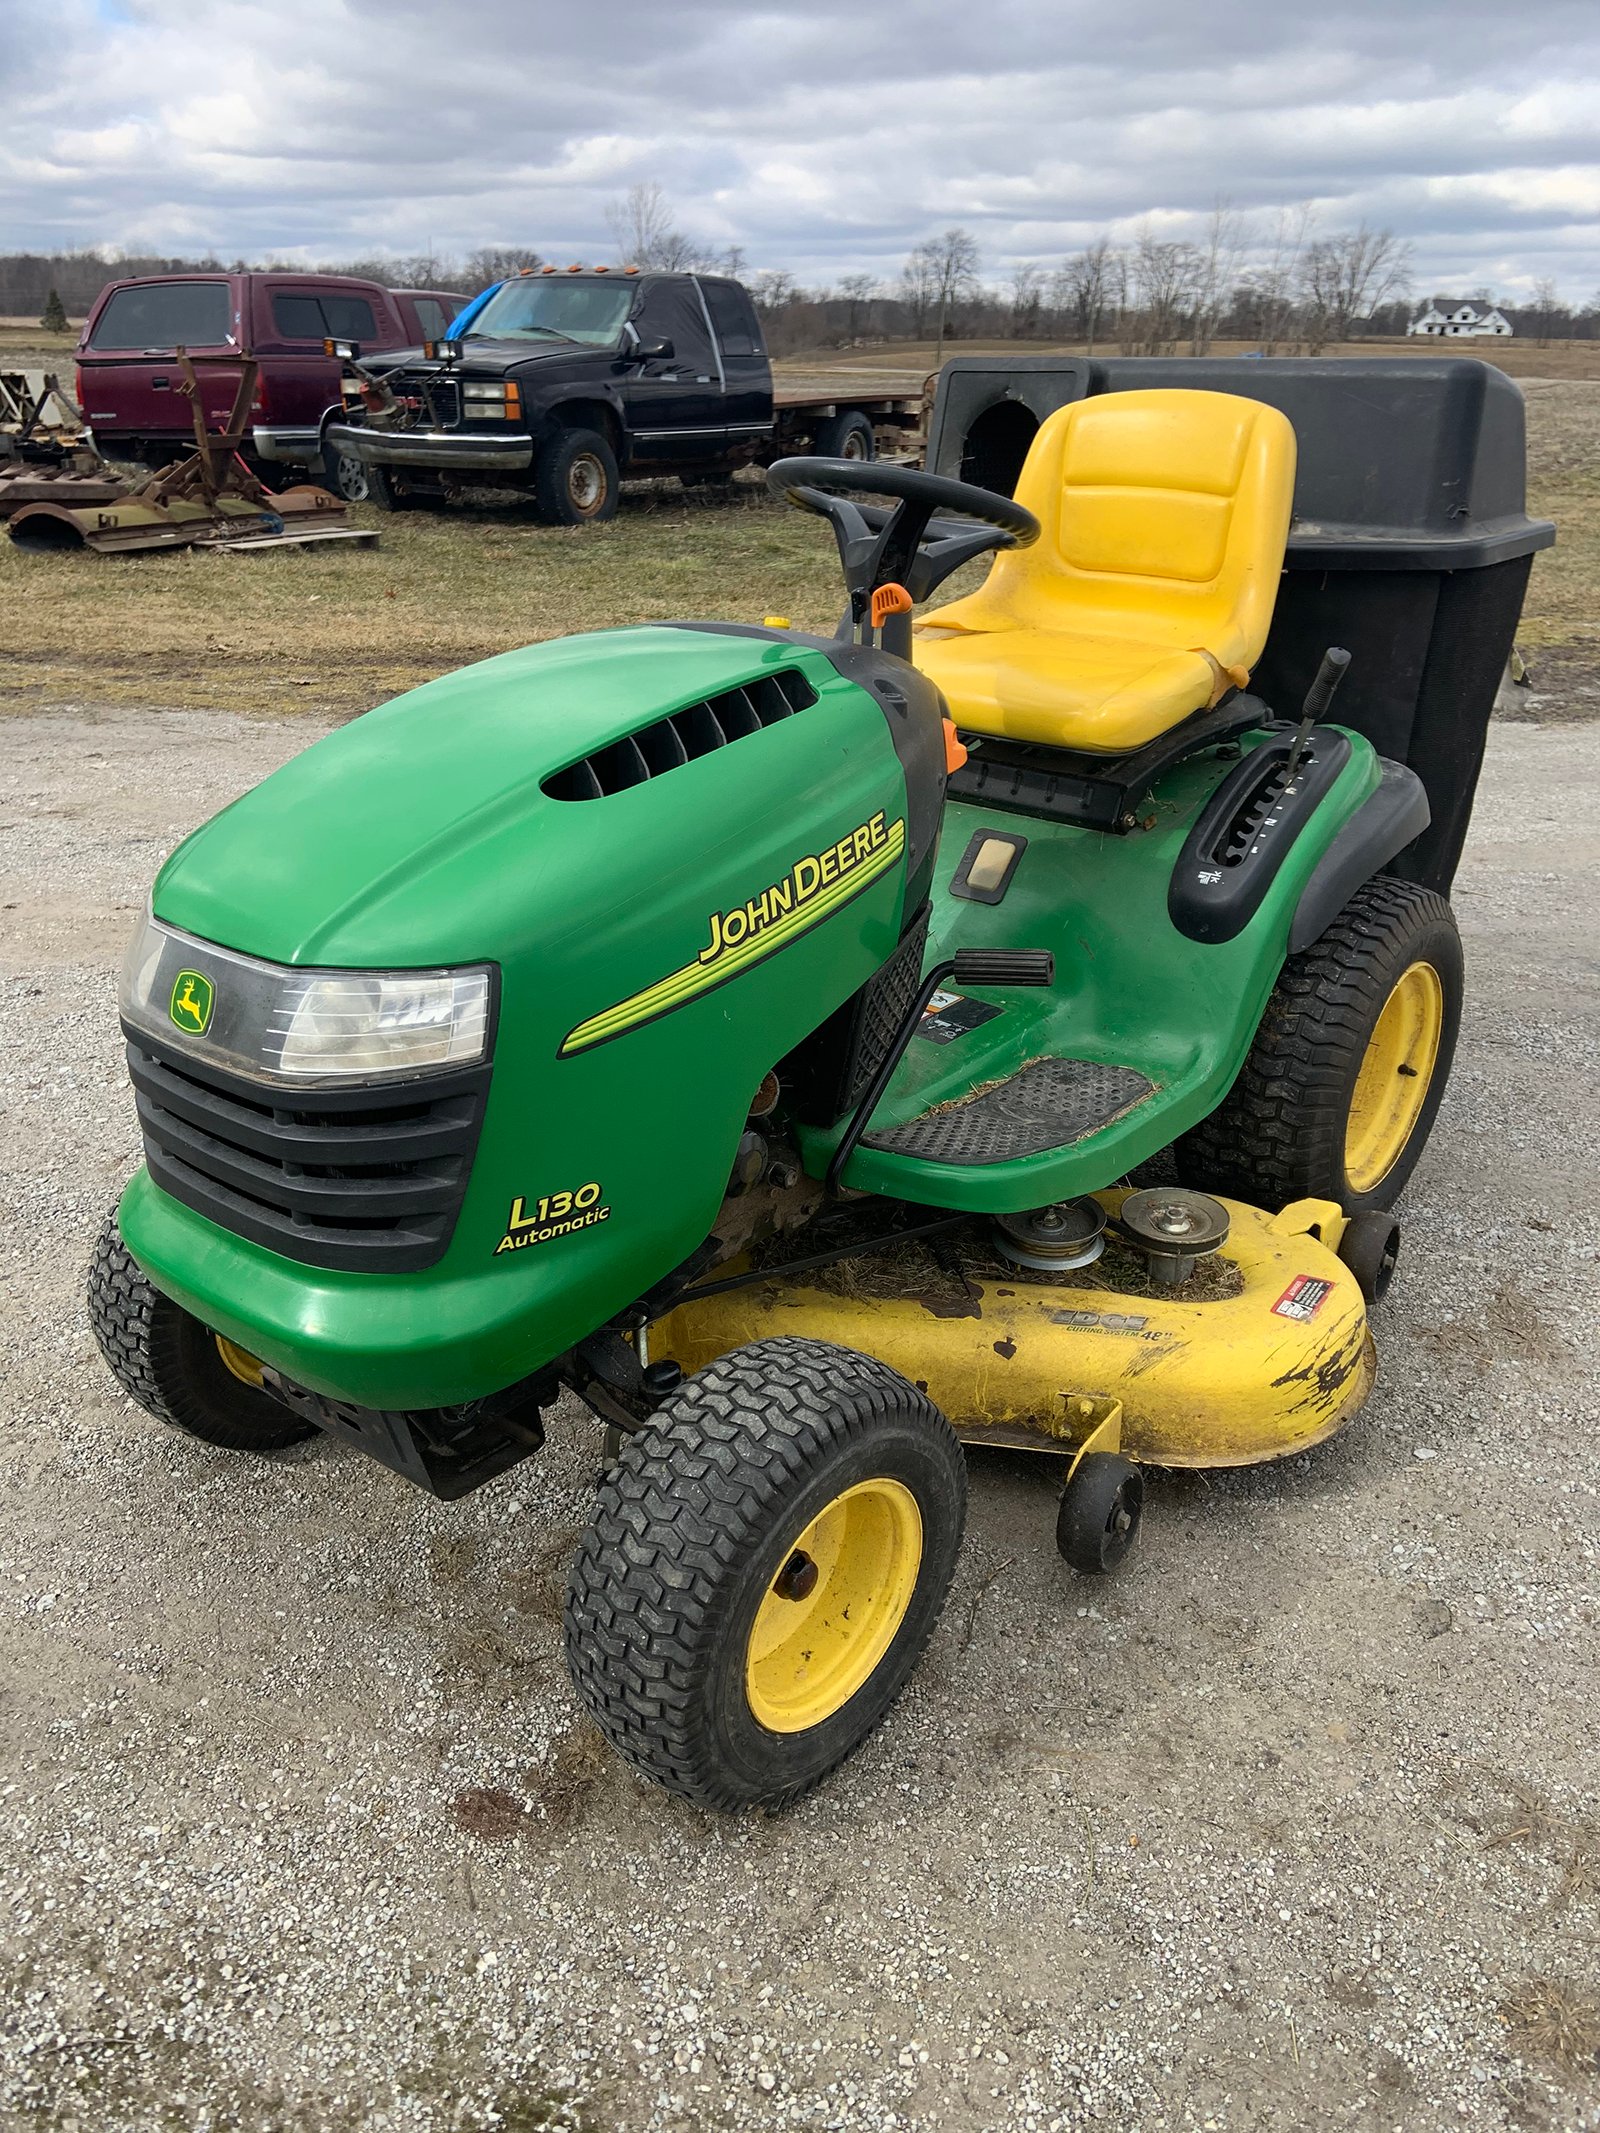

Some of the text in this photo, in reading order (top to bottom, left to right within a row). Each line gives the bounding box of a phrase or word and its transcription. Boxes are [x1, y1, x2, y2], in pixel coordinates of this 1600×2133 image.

[699, 809, 889, 965] JOHN DEERE
[495, 1206, 610, 1254] Automatic
[508, 1181, 602, 1231] L130
[1050, 1309, 1149, 1332] EDGE
[1066, 1325, 1104, 1335] CUTTING
[1103, 1329, 1140, 1338] SYSTEM
